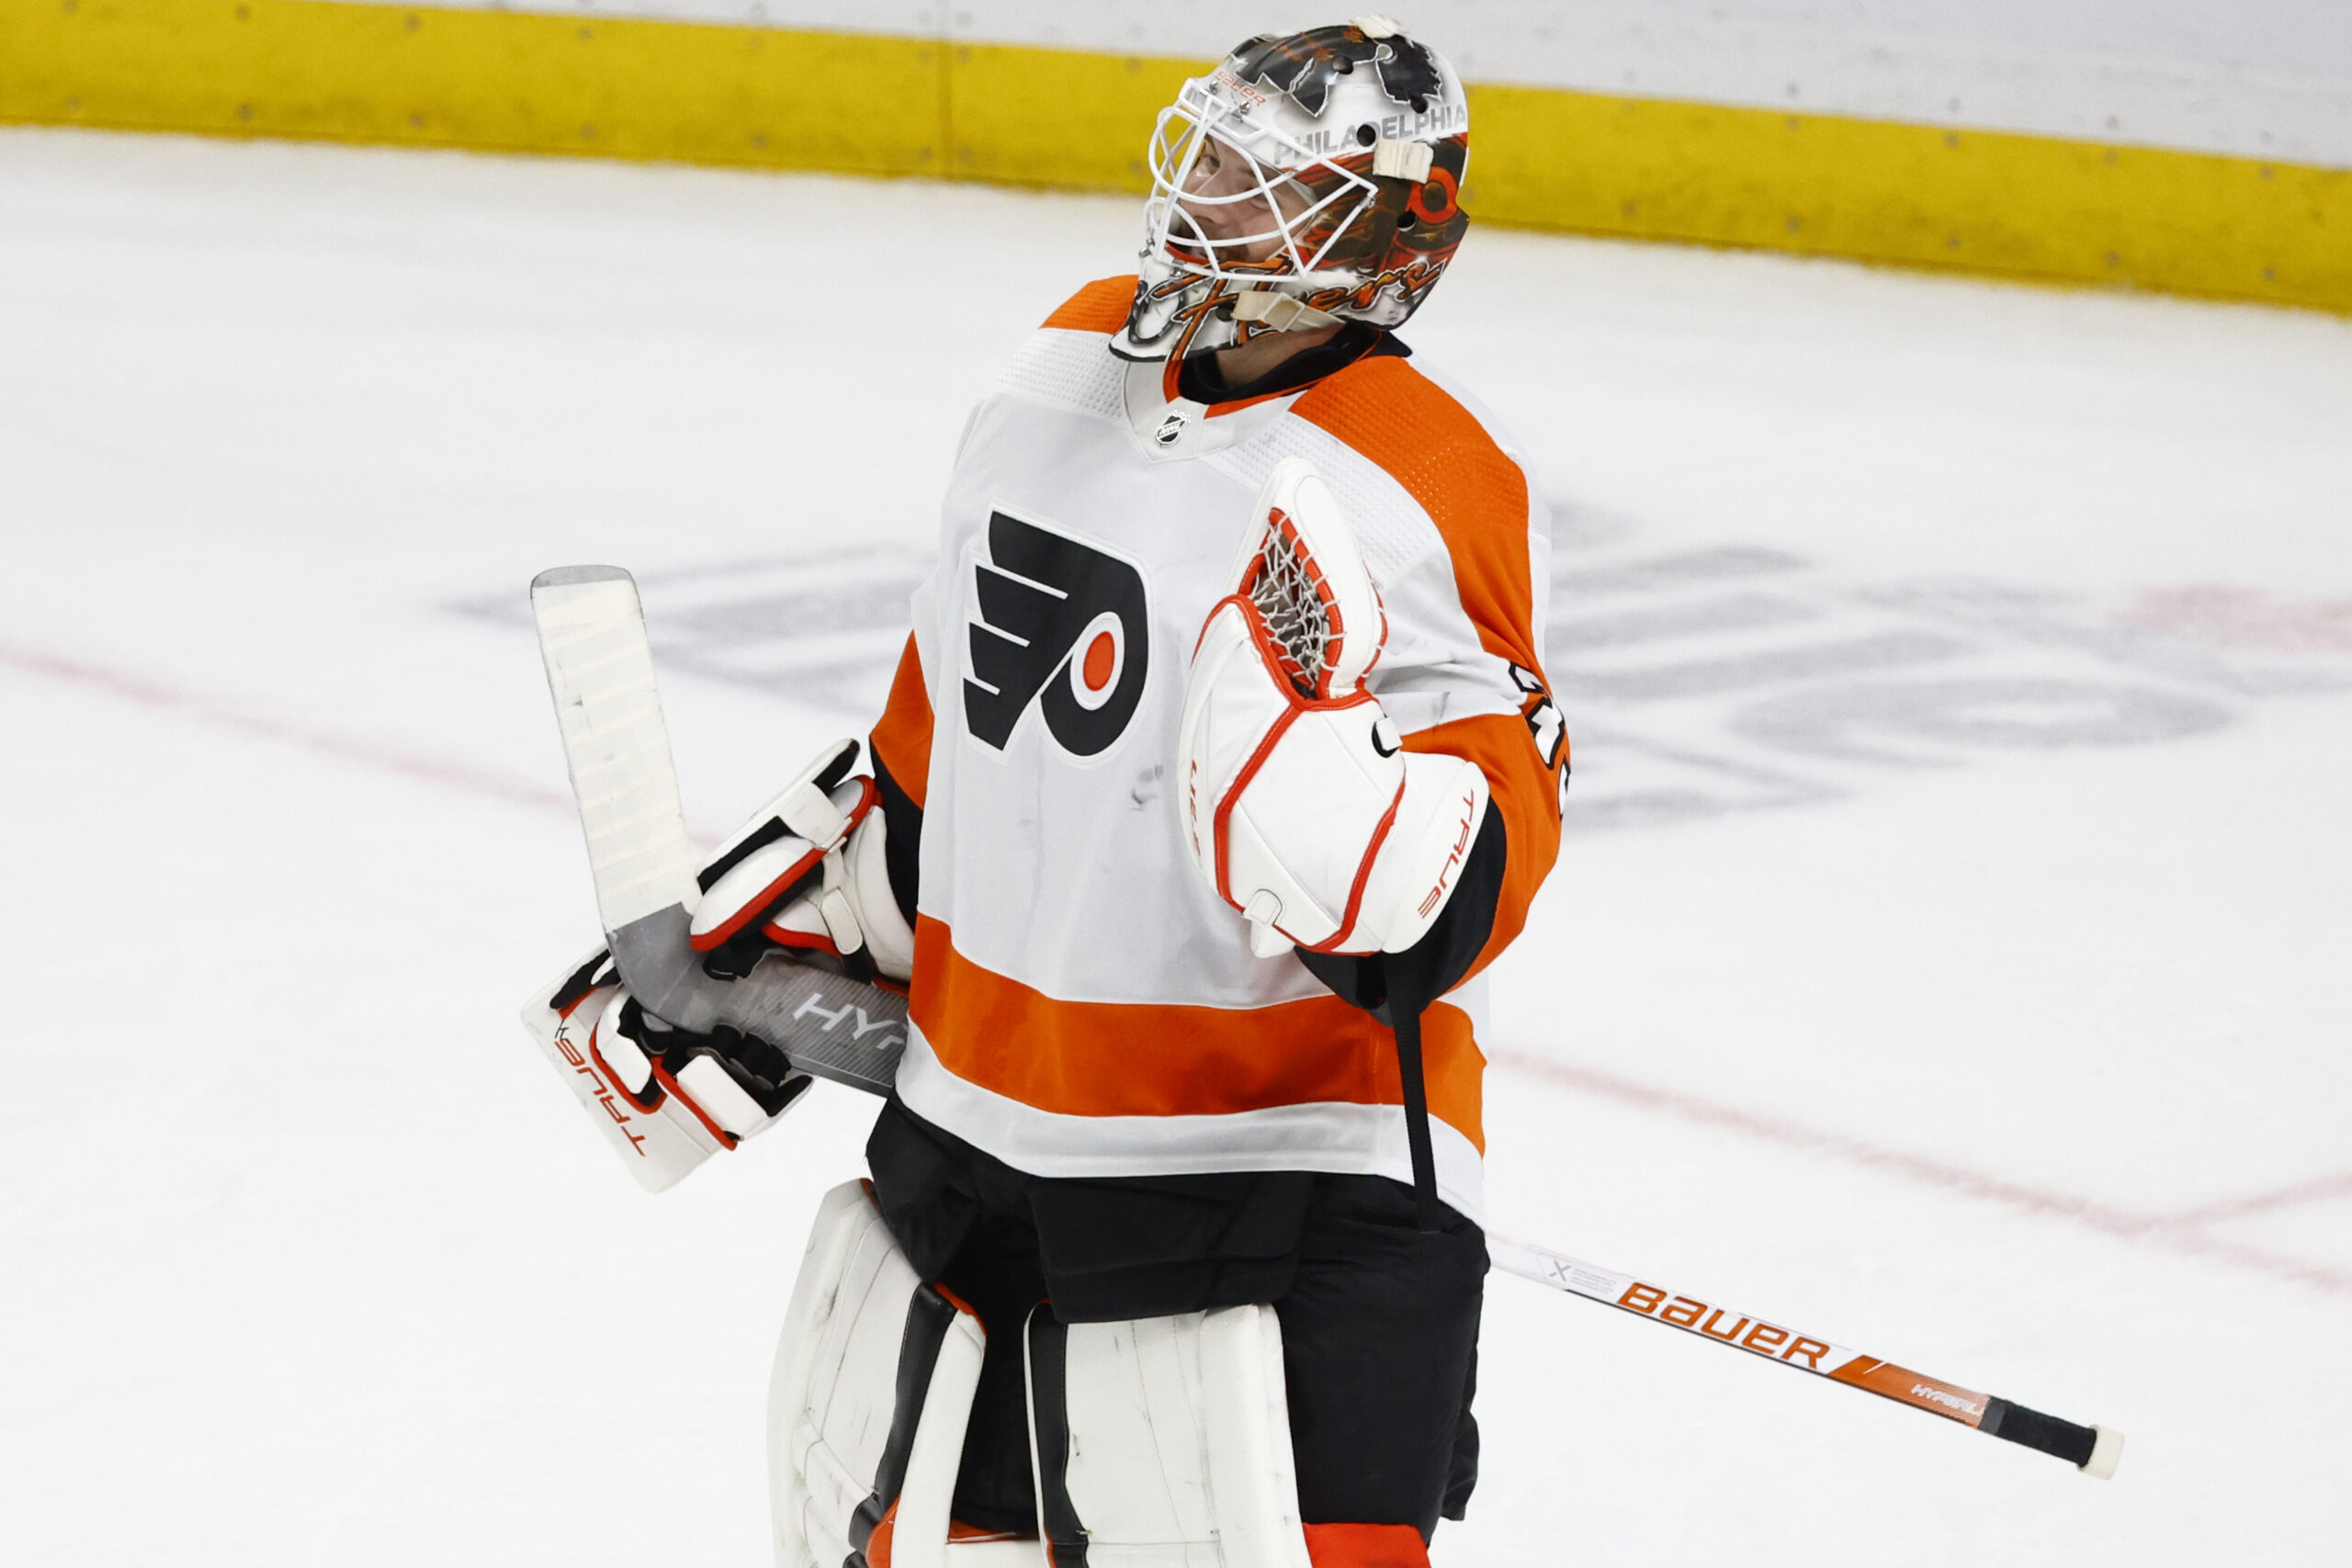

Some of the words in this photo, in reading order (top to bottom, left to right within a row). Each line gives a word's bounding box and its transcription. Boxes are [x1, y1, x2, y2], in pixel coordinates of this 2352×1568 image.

[1417, 787, 1475, 919] TRUE
[554, 1037, 646, 1157] TRUE
[1616, 1281, 1831, 1370] BAUER
